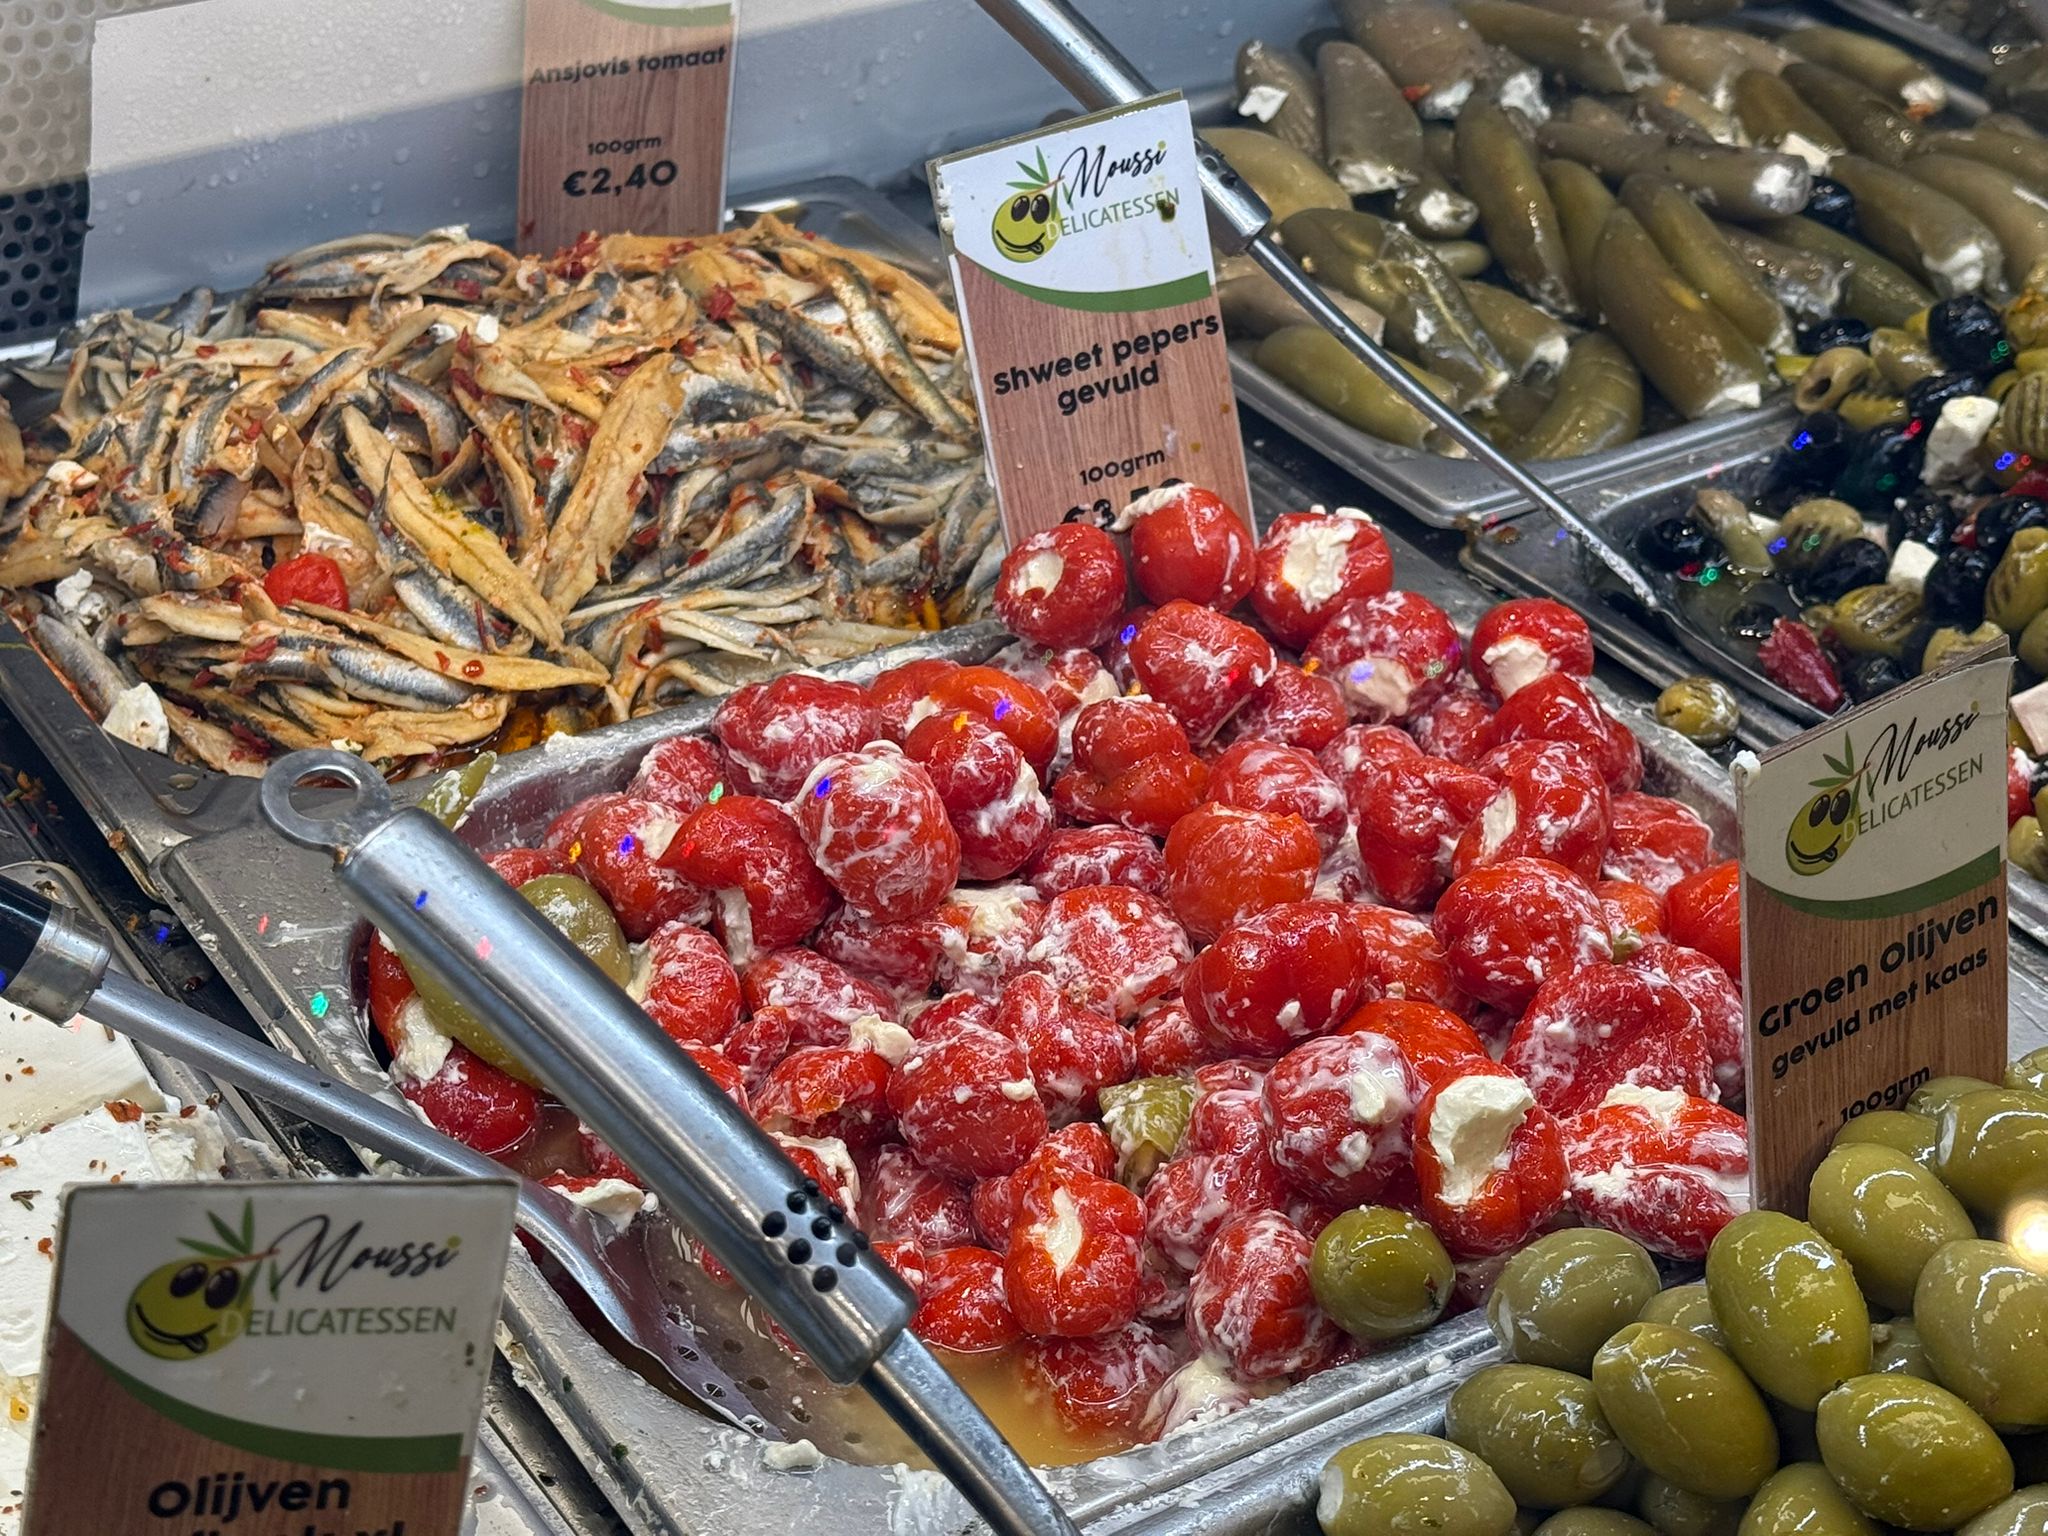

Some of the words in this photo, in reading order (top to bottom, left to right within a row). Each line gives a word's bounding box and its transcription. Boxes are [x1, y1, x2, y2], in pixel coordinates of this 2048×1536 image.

[529, 55, 631, 85] Ansjovis
[638, 46, 727, 73] tomaat
[588, 136, 662, 155] 100grm
[1057, 140, 1167, 205] Moussi
[562, 160, 678, 197] €2,40
[1046, 188, 1180, 242] DELICATESSEN
[1112, 315, 1220, 367] pepers
[1057, 360, 1160, 416] gevuld
[1080, 450, 1166, 485] 100grm
[1863, 701, 1980, 798] Moussi
[1843, 753, 1984, 843] DELICATESSEN
[1758, 963, 1869, 1038] Groen
[1880, 895, 1998, 974] Olijven
[1771, 1010, 1861, 1080] gevuld
[1868, 980, 1918, 1024] met
[1925, 946, 1988, 995] kaas
[1841, 1066, 1931, 1125] 100grm
[268, 1213, 462, 1293] Moussi
[220, 1306, 457, 1338] DELICATESSEN
[148, 1472, 351, 1524] Olijven
